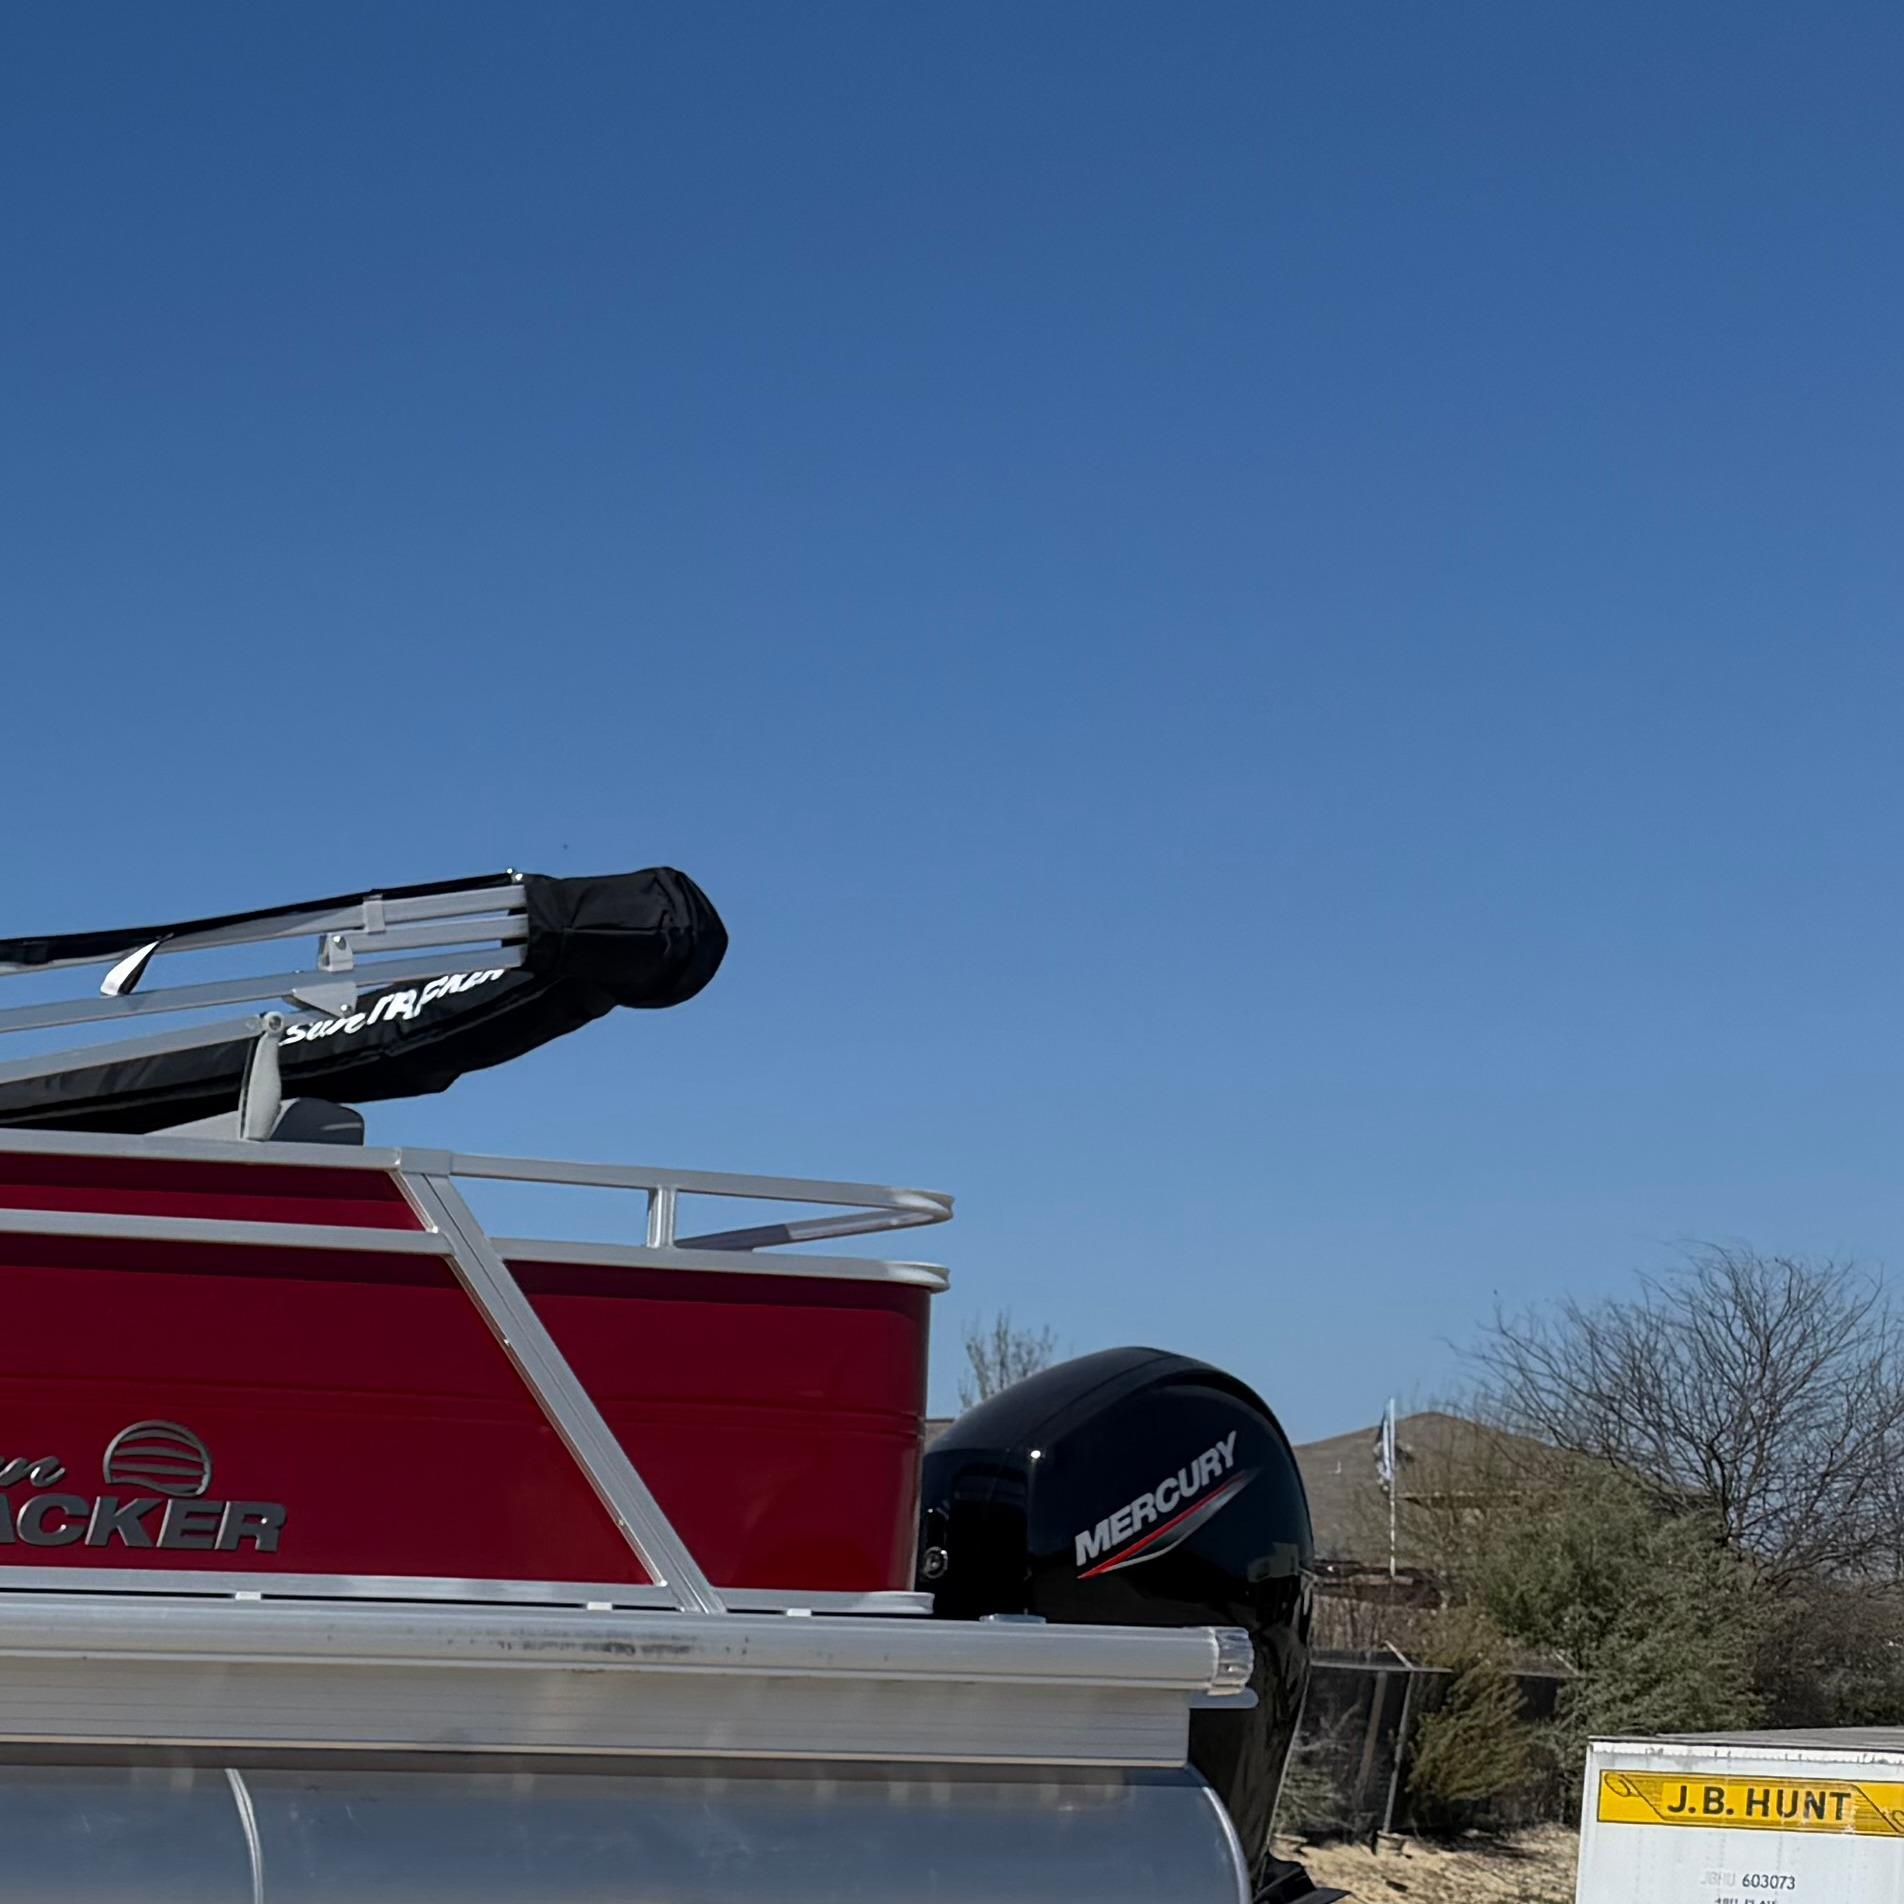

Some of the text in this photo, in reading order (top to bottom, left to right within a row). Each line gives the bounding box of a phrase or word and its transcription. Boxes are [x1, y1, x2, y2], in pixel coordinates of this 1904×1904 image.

[1075, 1431, 1237, 1566] MERCURY
[1746, 1788, 1852, 1820] HUNT
[1742, 1874, 1796, 1890] 603073
